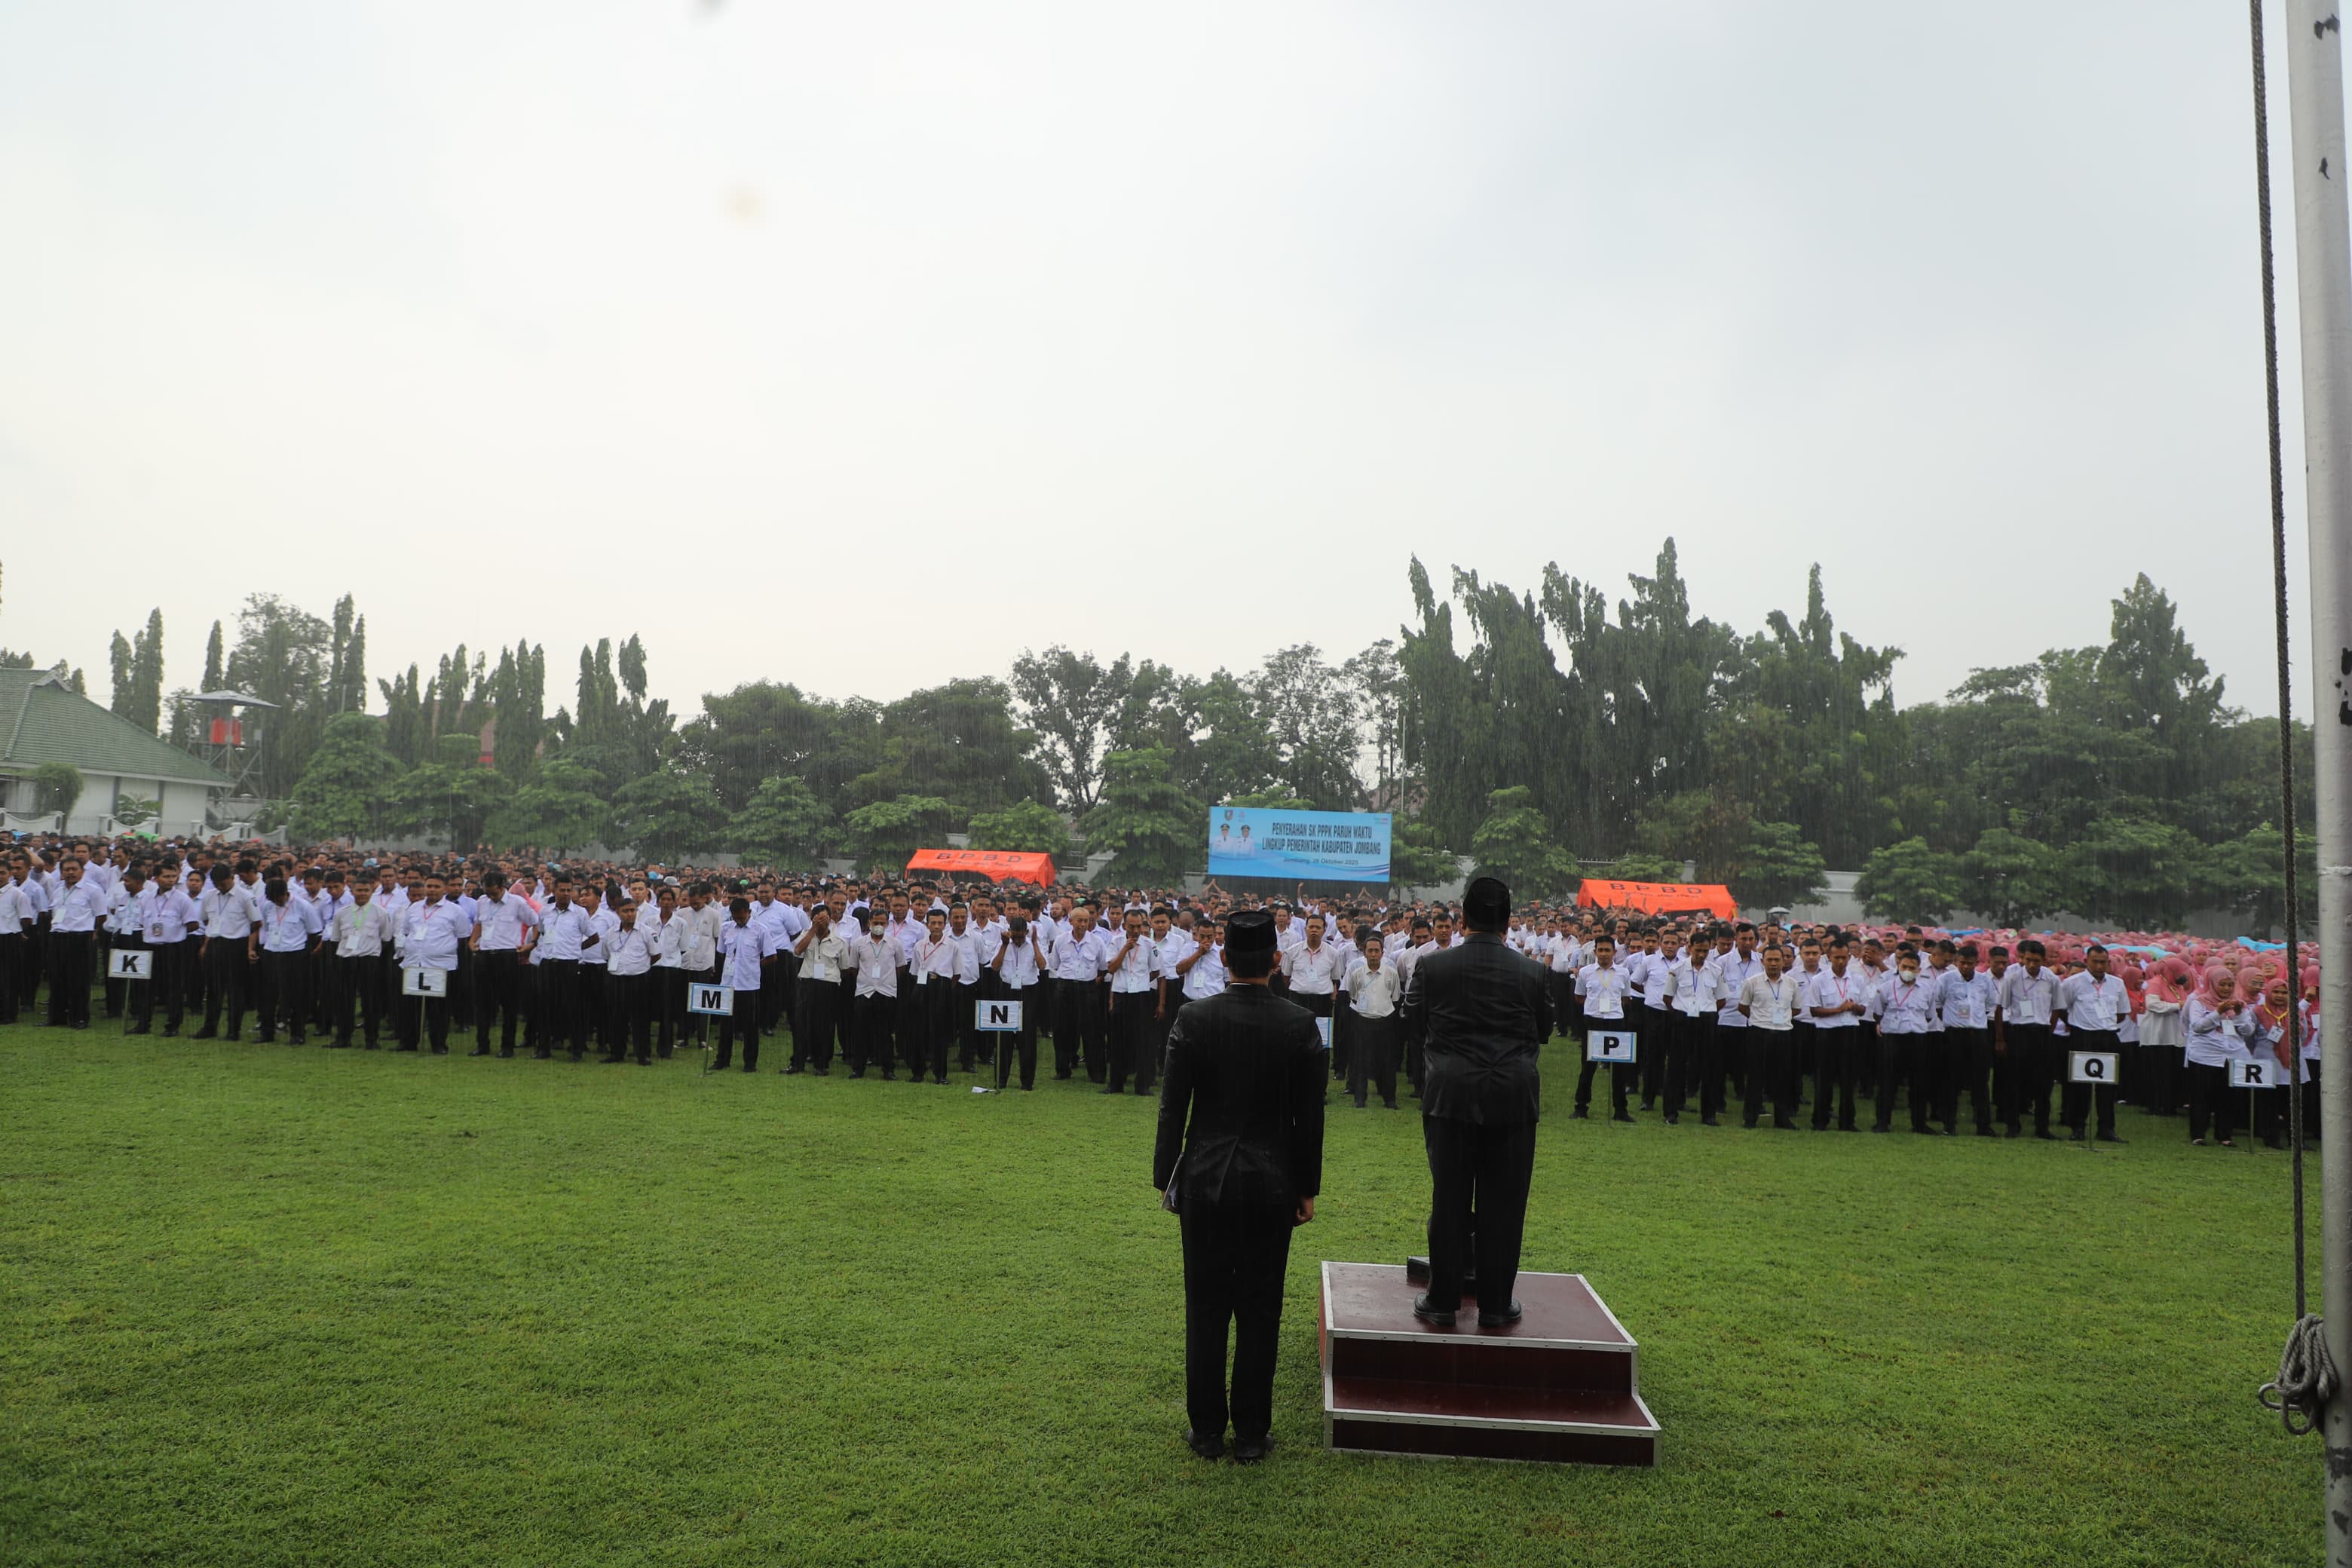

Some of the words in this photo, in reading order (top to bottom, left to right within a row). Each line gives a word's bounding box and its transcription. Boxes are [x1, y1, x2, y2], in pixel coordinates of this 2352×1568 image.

[1272, 822, 1307, 837] PENYERAHAN
[1308, 824, 1316, 837] SK
[1318, 825, 1332, 838] PPPK
[1333, 825, 1352, 838] PARUH
[1353, 825, 1372, 839] WAKTU
[1262, 838, 1285, 850] LINGKUP
[1286, 838, 1320, 853] PEMERINTAH
[1321, 840, 1353, 854] KABUPATEN
[1354, 841, 1381, 855] JOMBANG
[936, 853, 1022, 863] BPBD
[1609, 883, 1702, 894] BPBD
[121, 954, 139, 972] K
[418, 972, 431, 991] L
[701, 989, 721, 1010] M
[990, 1005, 1009, 1024] N
[1603, 1036, 1620, 1055] P
[2084, 1058, 2104, 1080] Q
[2245, 1064, 2263, 1084] R
